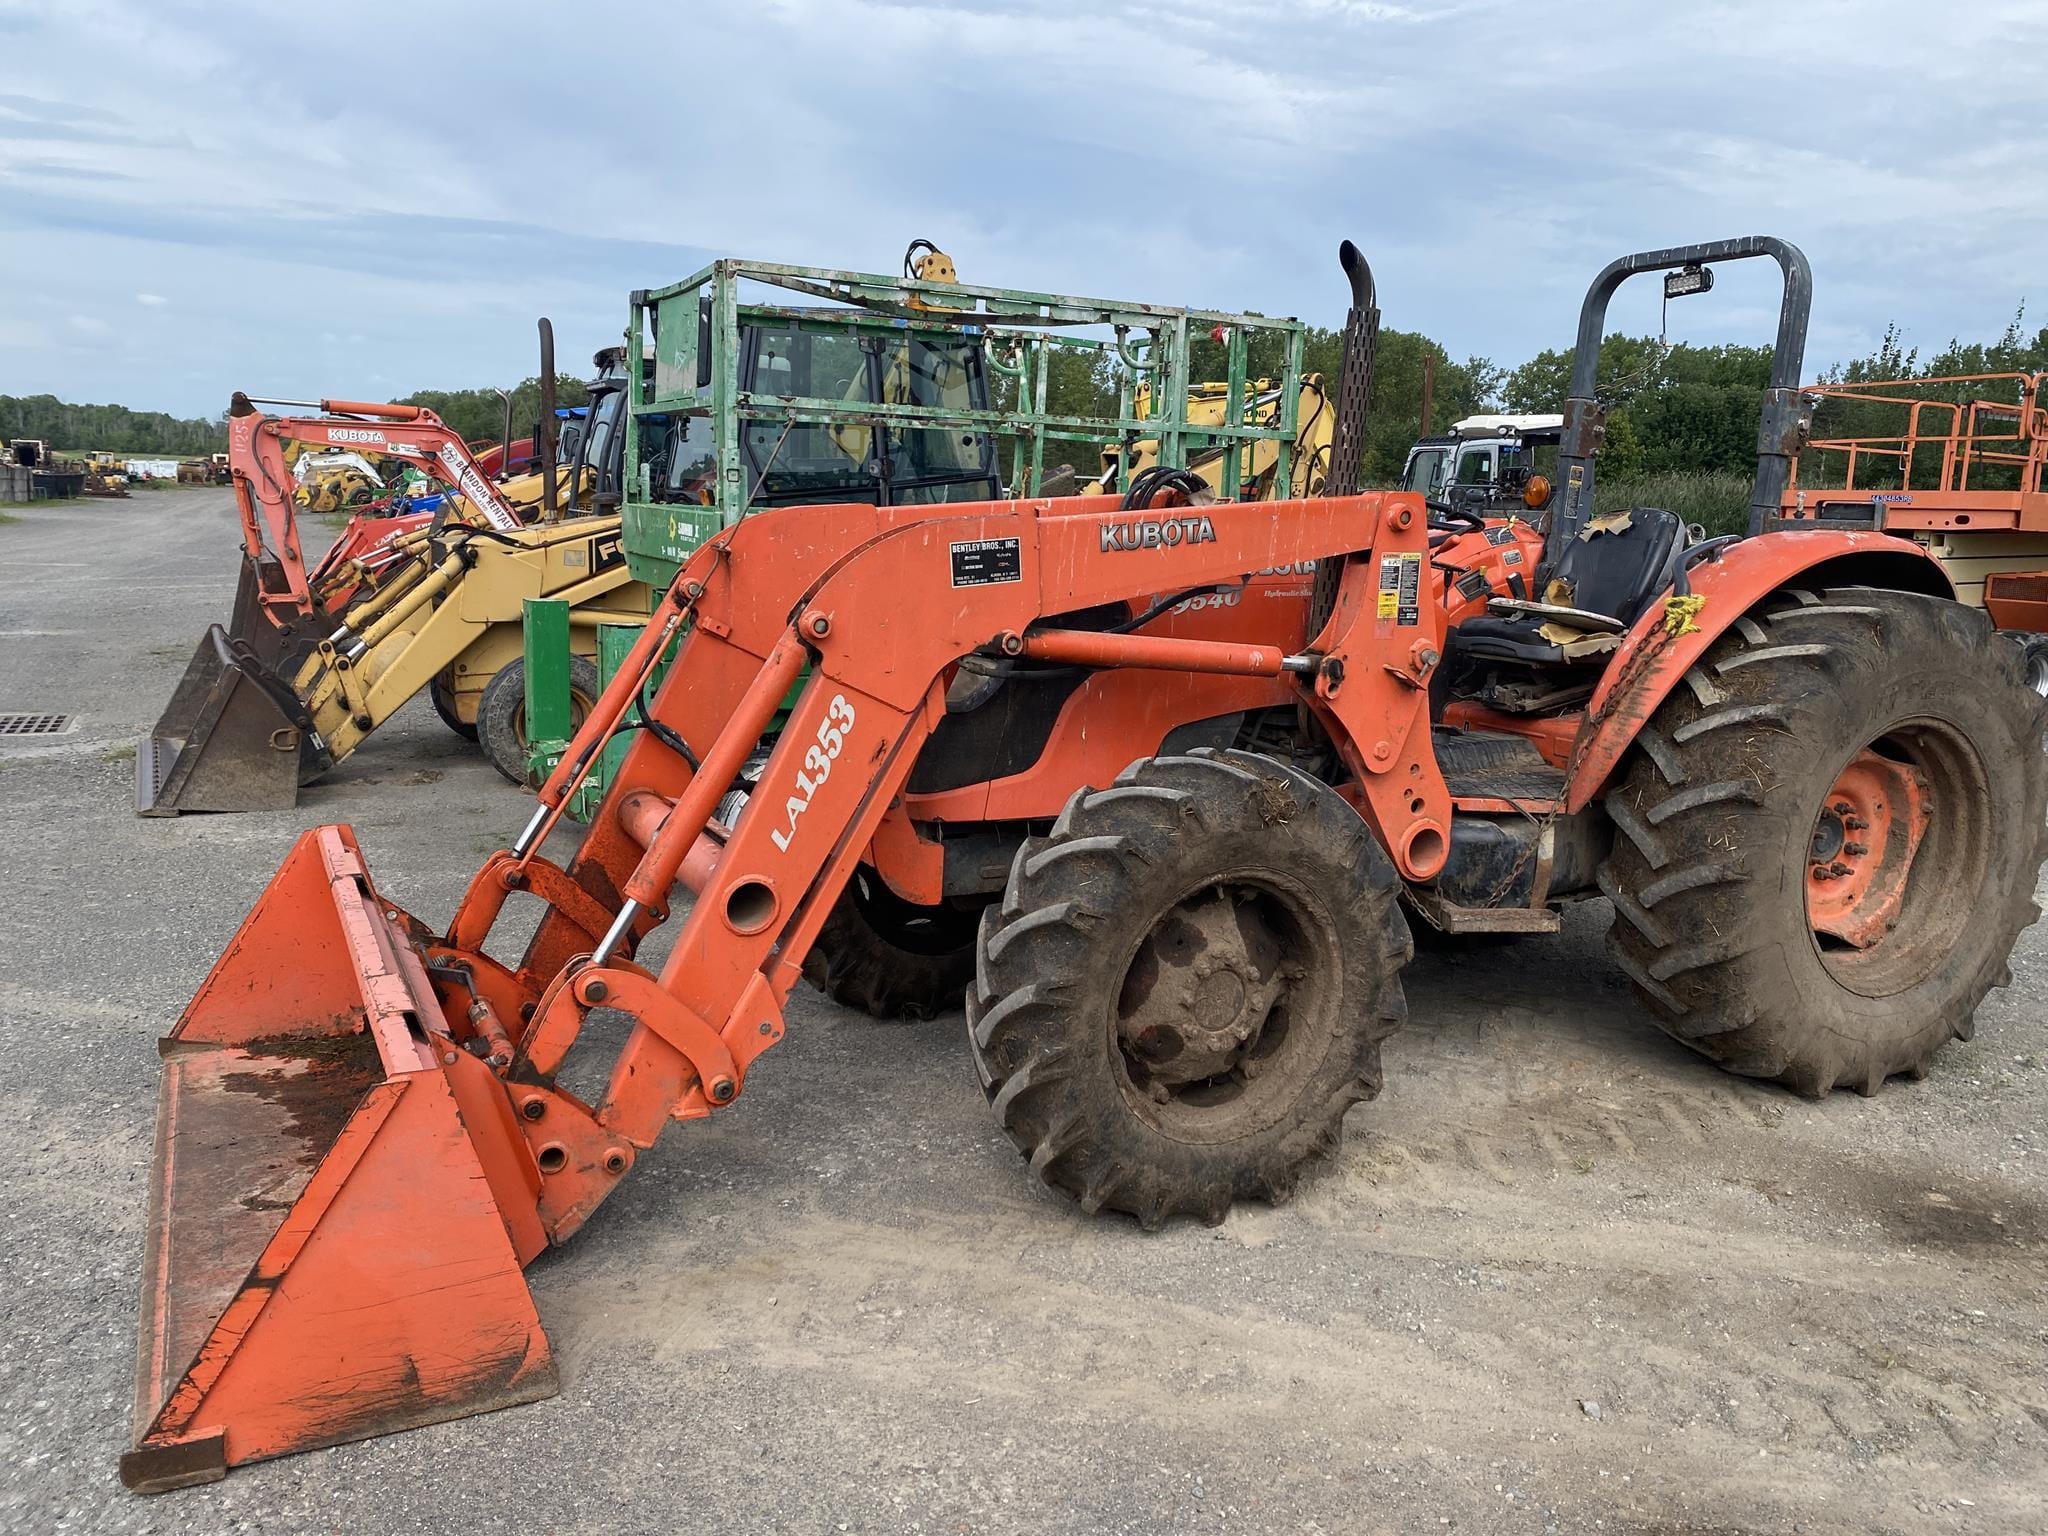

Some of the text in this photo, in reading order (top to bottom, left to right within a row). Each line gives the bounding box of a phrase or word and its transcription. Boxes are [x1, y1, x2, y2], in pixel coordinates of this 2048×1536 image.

[328, 428, 386, 443] KUBOTA
[456, 461, 489, 498] BRANDON
[952, 543, 980, 553] BENTLEY
[1005, 540, 1019, 548] INC.
[1100, 516, 1216, 552] KUBOTA
[1264, 590, 1299, 598] Hydraulic
[771, 694, 855, 853] LA1353
